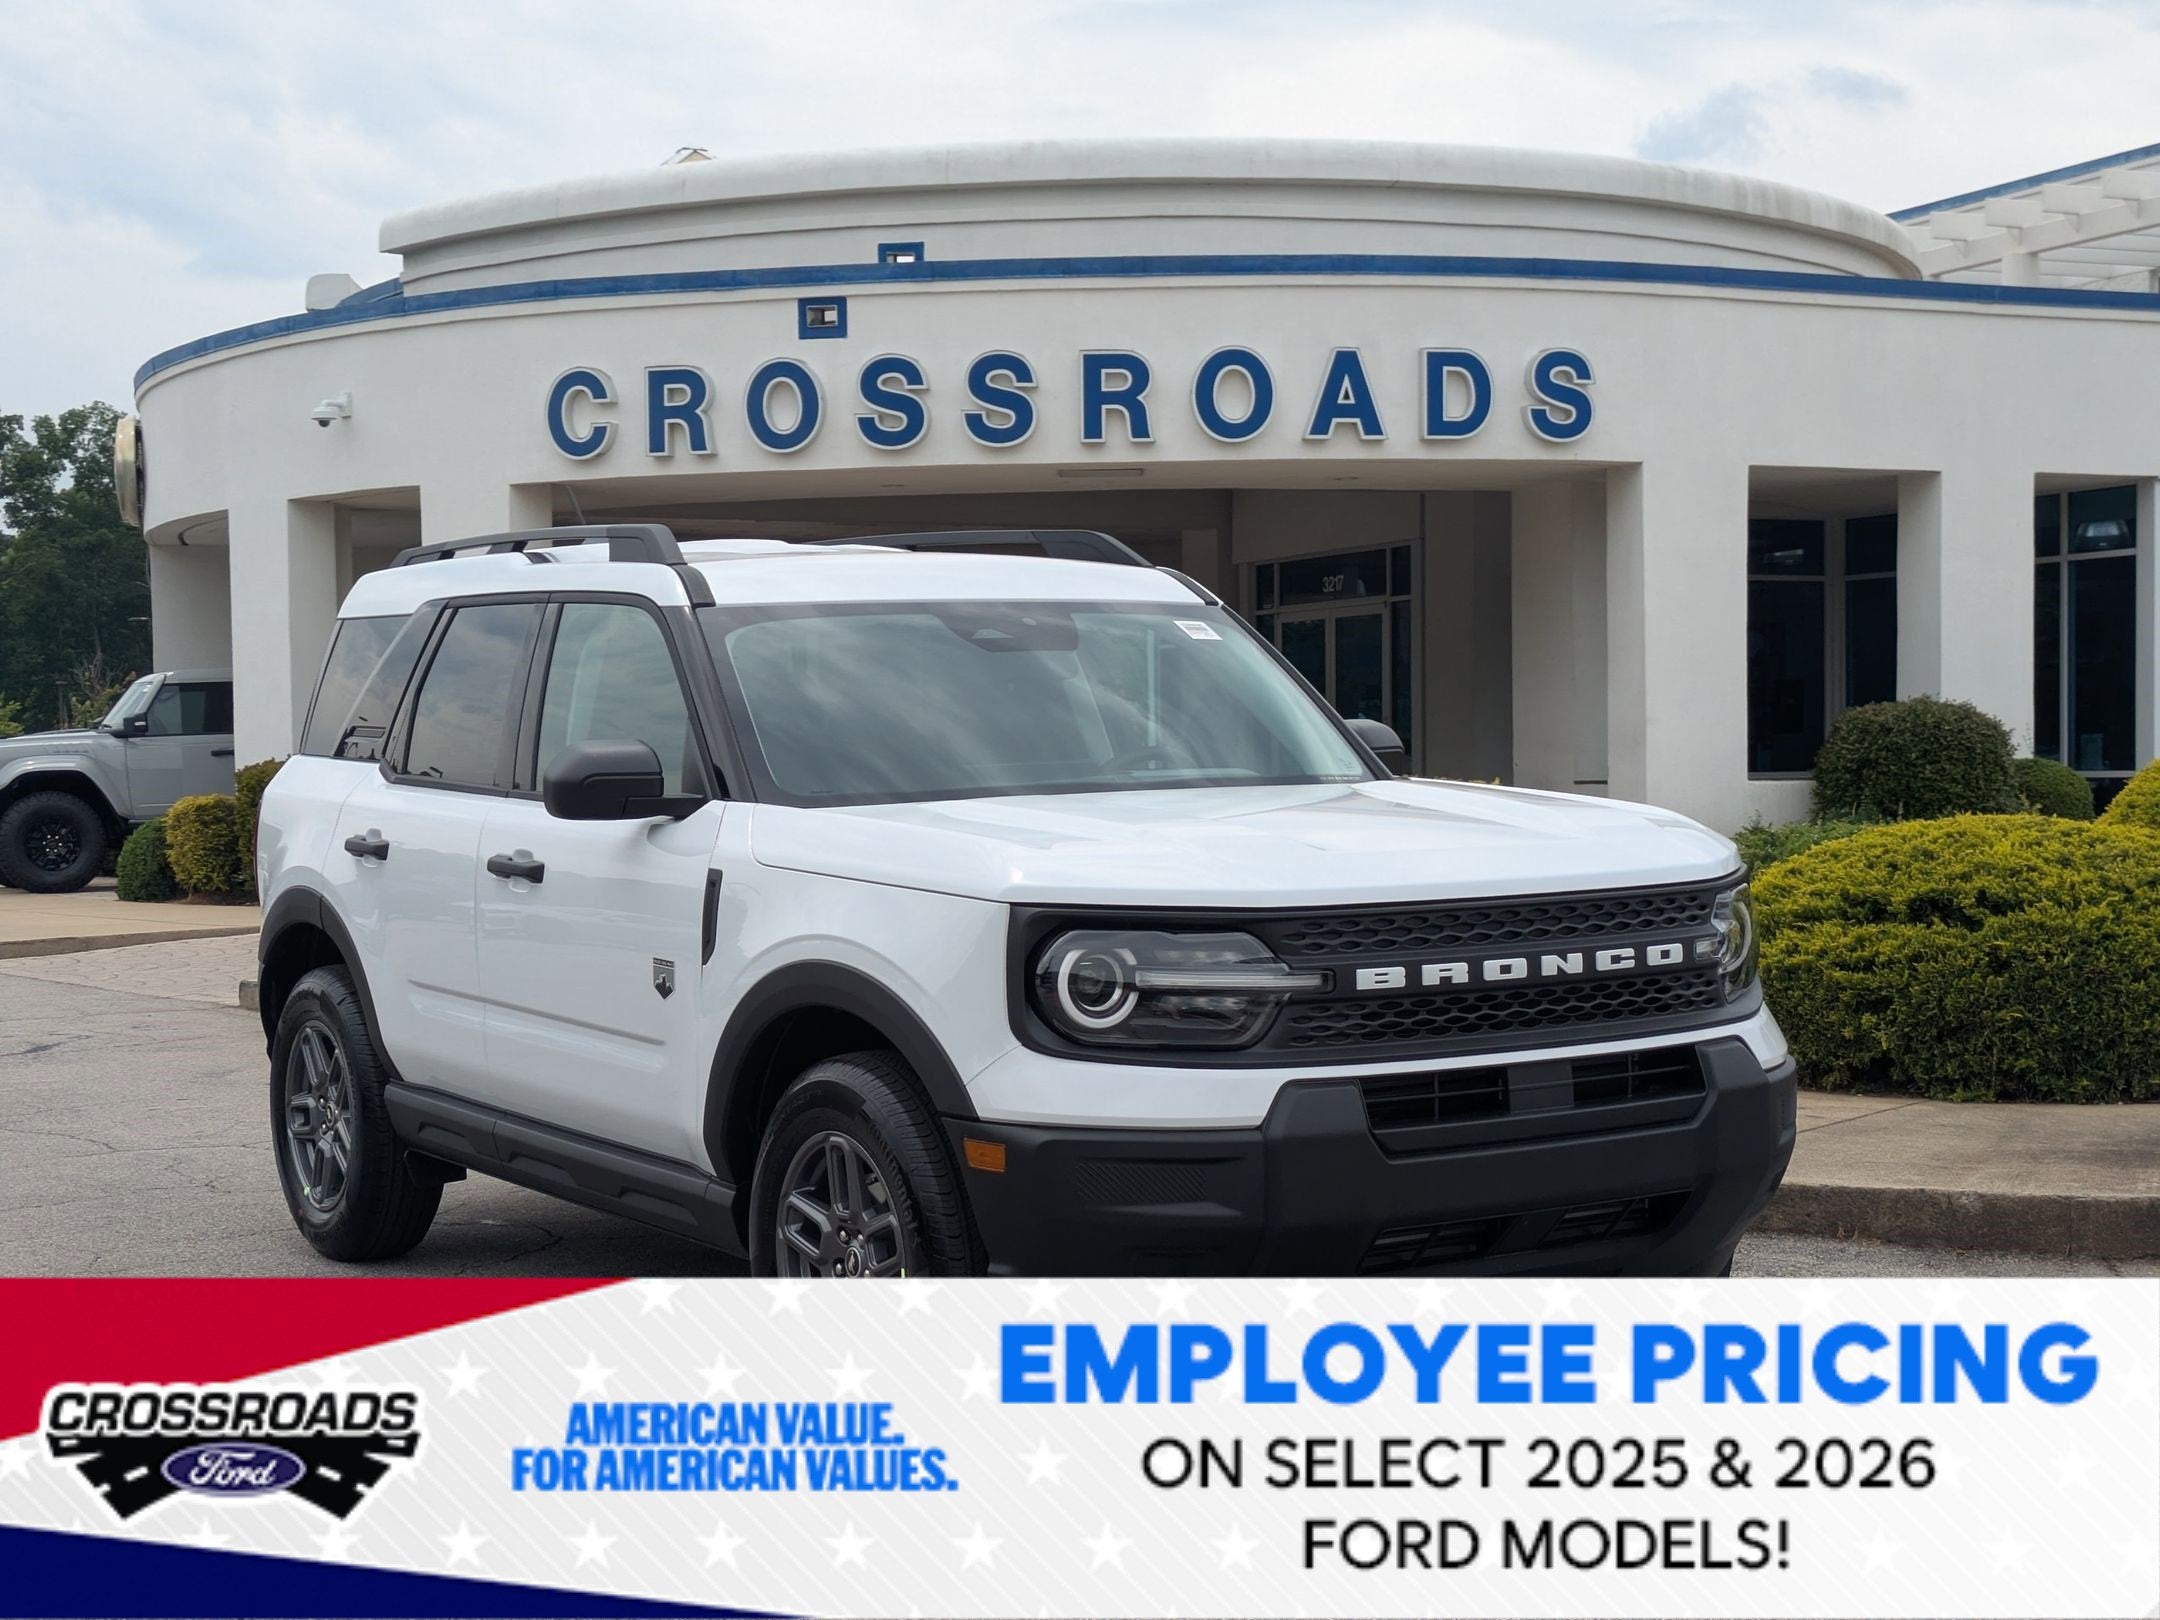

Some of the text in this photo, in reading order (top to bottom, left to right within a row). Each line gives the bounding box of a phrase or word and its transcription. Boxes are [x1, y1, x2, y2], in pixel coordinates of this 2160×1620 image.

[545, 344, 1596, 462] CROSSROADS
[1322, 575, 1344, 593] 3217
[1355, 943, 1684, 990] BRONCO
